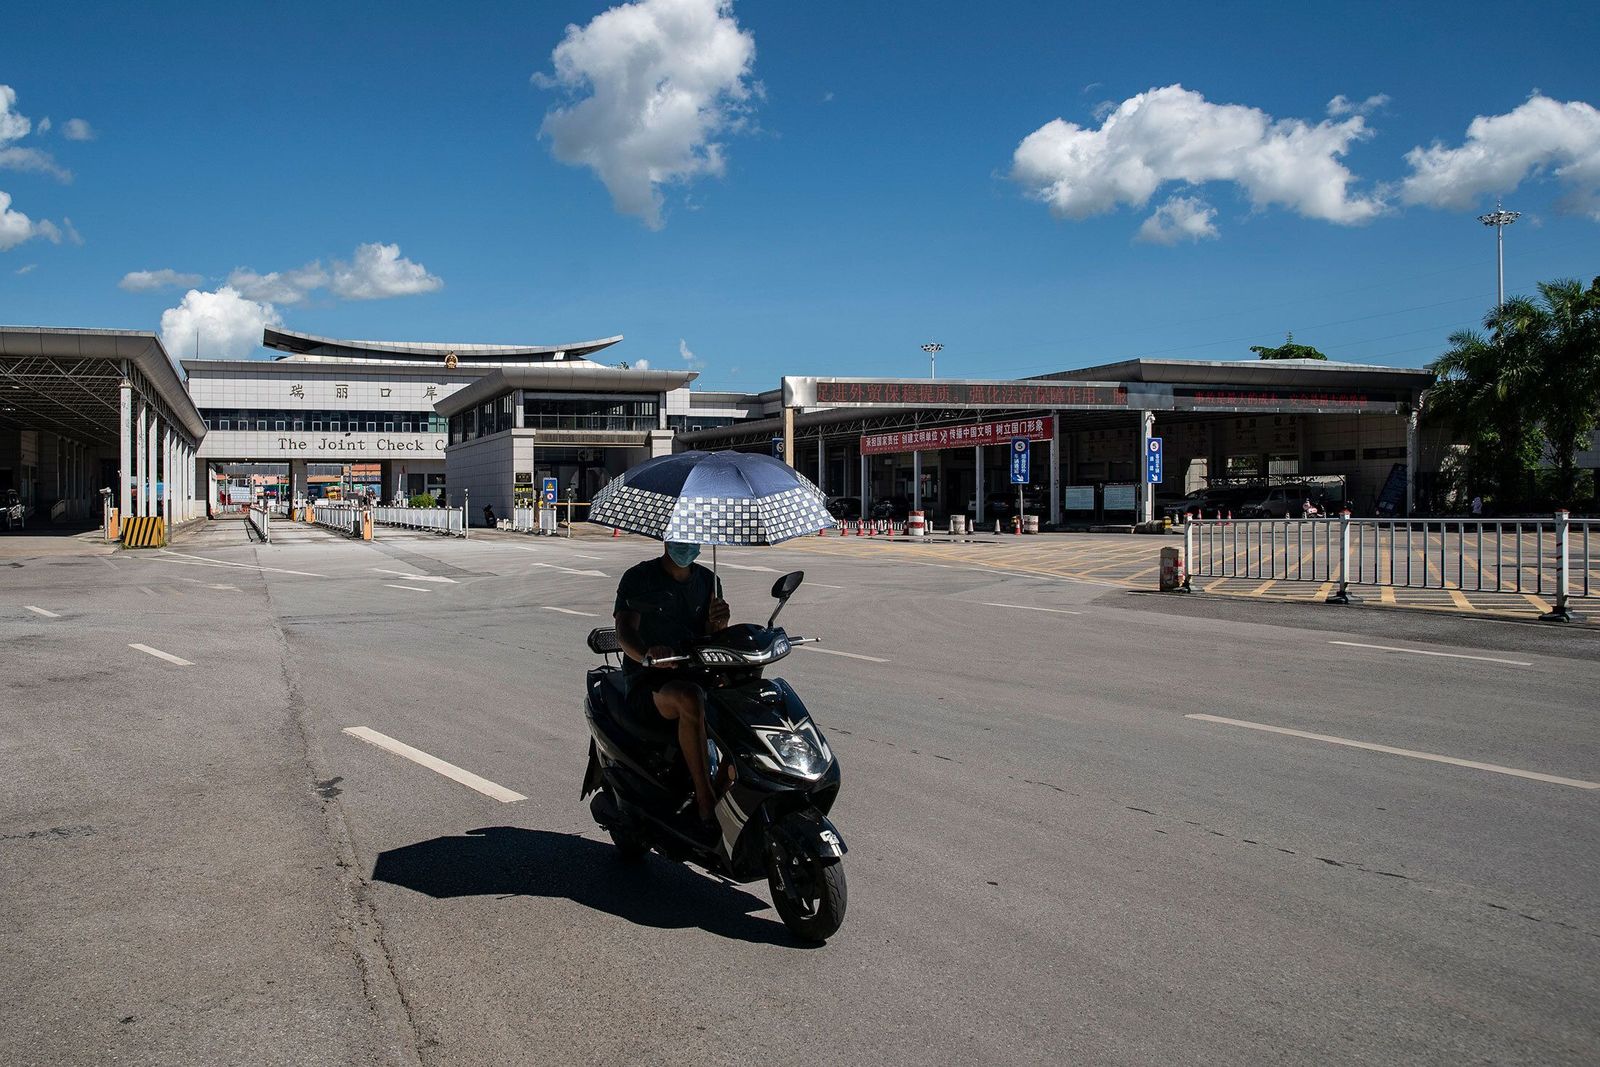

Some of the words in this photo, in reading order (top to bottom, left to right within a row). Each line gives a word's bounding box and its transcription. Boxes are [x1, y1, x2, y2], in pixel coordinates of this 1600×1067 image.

[289, 383, 438, 401] 瑞丽口岸
[866, 434, 899, 447] 承担国家责任
[902, 430, 938, 444] 创建文明单位
[949, 425, 992, 440] 传播中国文明
[995, 419, 1044, 435] 树立国门形象
[278, 438, 307, 450] The
[318, 438, 366, 451] Joint
[376, 438, 425, 451] Check
[435, 439, 448, 450] C
